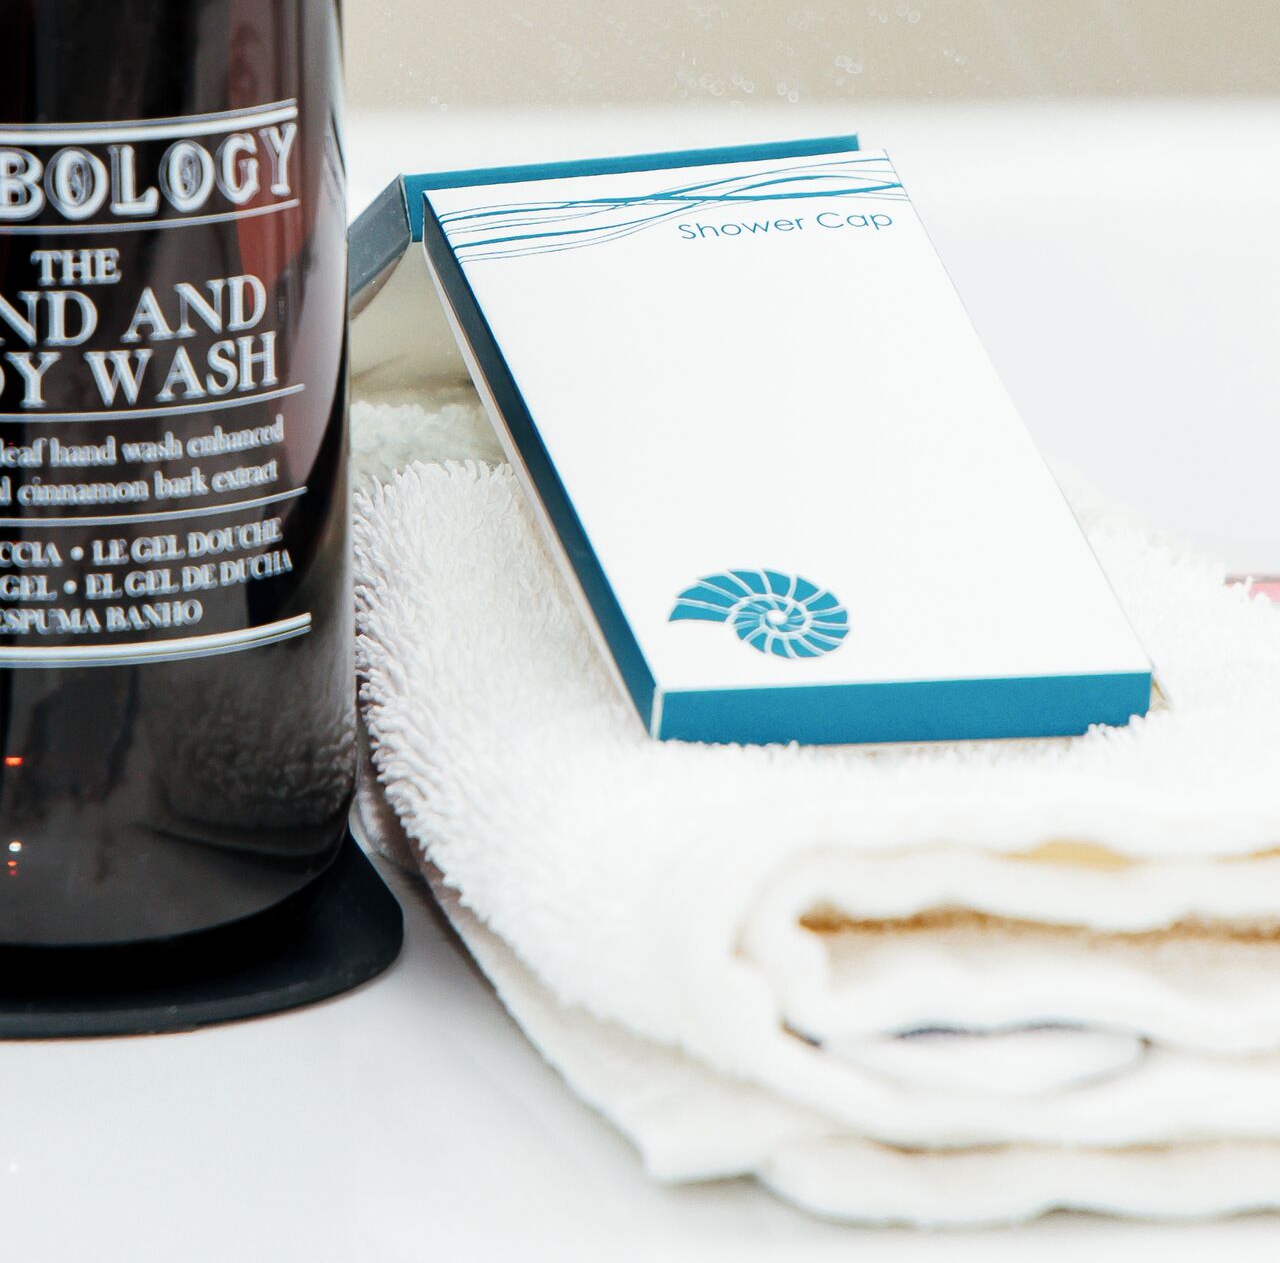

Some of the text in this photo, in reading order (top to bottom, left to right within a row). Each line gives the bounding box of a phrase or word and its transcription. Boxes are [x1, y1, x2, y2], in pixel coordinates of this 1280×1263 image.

[678, 211, 894, 240] Shower Cap
[31, 248, 121, 285] THE
[122, 274, 267, 343] AND
[84, 330, 279, 406] WASH
[50, 436, 117, 468] hand
[122, 431, 183, 463] wash
[187, 414, 285, 458] enhanced
[18, 475, 149, 506] cinnamon
[154, 467, 208, 500] bark
[211, 459, 278, 494] extract
[93, 536, 128, 566] LE
[131, 534, 184, 565] GEL
[188, 517, 283, 557] DOUCHE
[86, 569, 121, 601] EL
[124, 566, 178, 597] GEL
[182, 564, 217, 592] DE
[220, 549, 294, 587] DUCHA
[106, 599, 204, 631] BANHO
